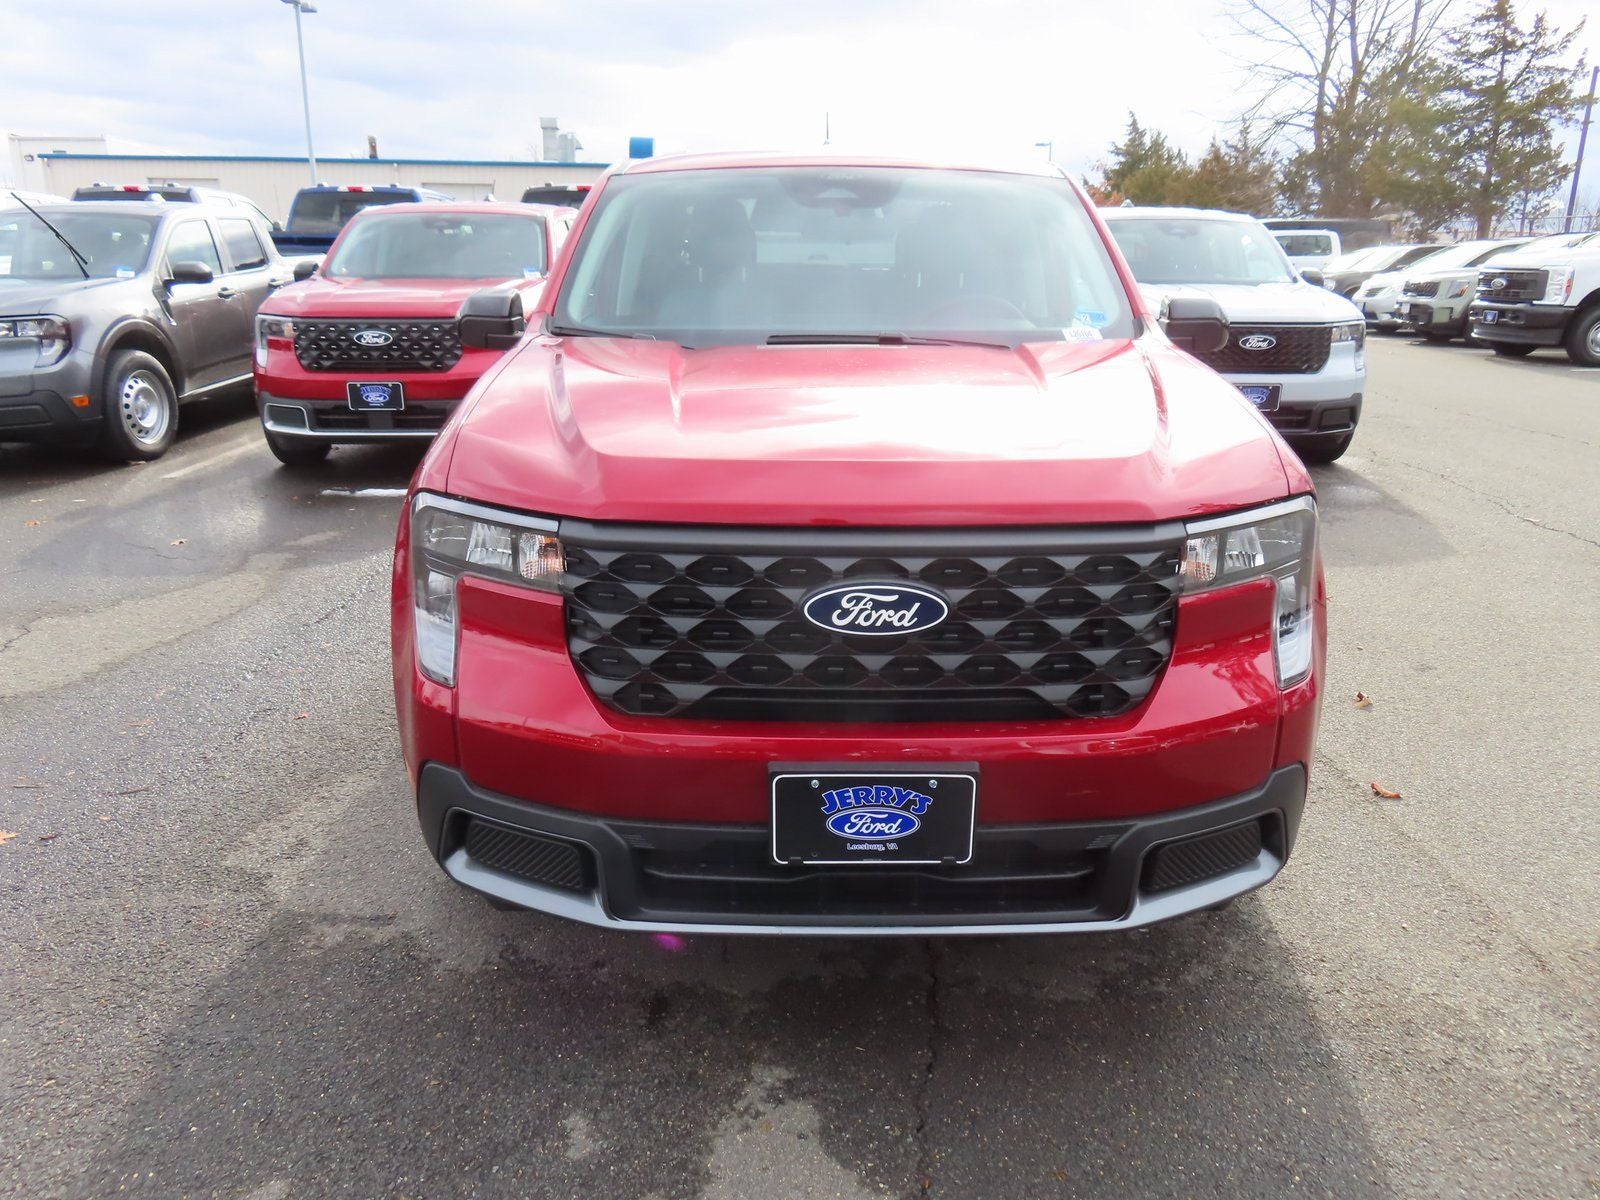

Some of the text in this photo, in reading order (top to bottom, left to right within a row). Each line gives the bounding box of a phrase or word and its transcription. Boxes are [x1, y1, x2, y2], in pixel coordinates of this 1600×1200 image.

[831, 592, 921, 627] Ford
[821, 785, 933, 815] JERRY'S
[844, 812, 902, 834] Ford
